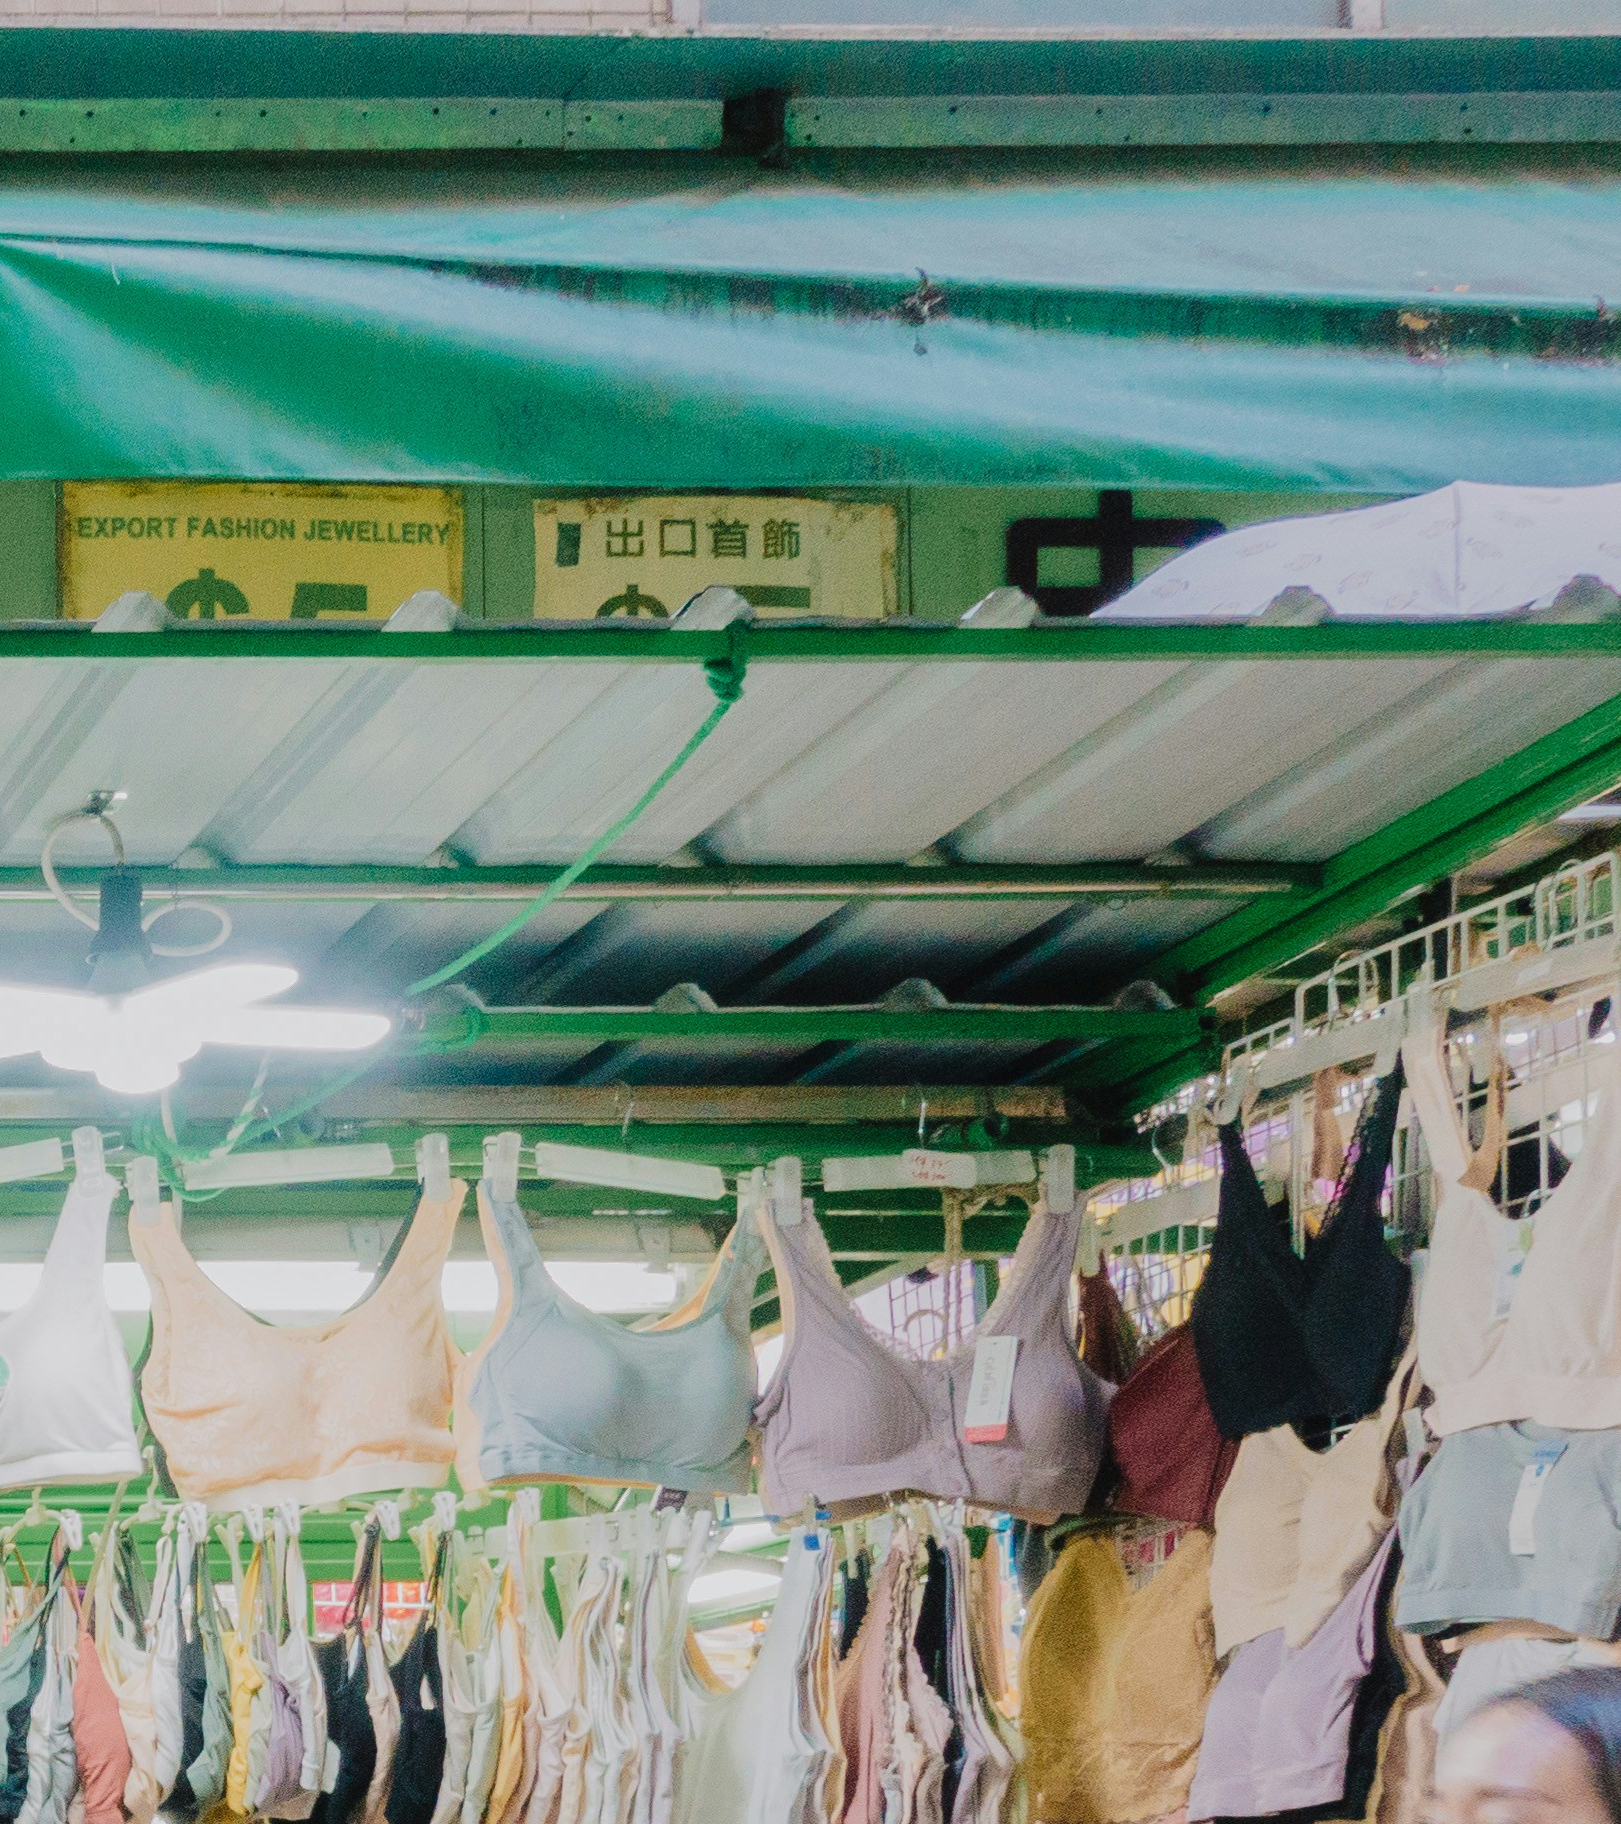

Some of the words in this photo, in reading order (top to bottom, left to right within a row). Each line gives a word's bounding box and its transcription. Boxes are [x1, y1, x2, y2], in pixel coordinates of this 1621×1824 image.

[77, 517, 177, 540] EXPORT
[186, 517, 296, 541] FASHION
[303, 518, 451, 546] JEWELLERY
[605, 517, 801, 561] 出口首飾
